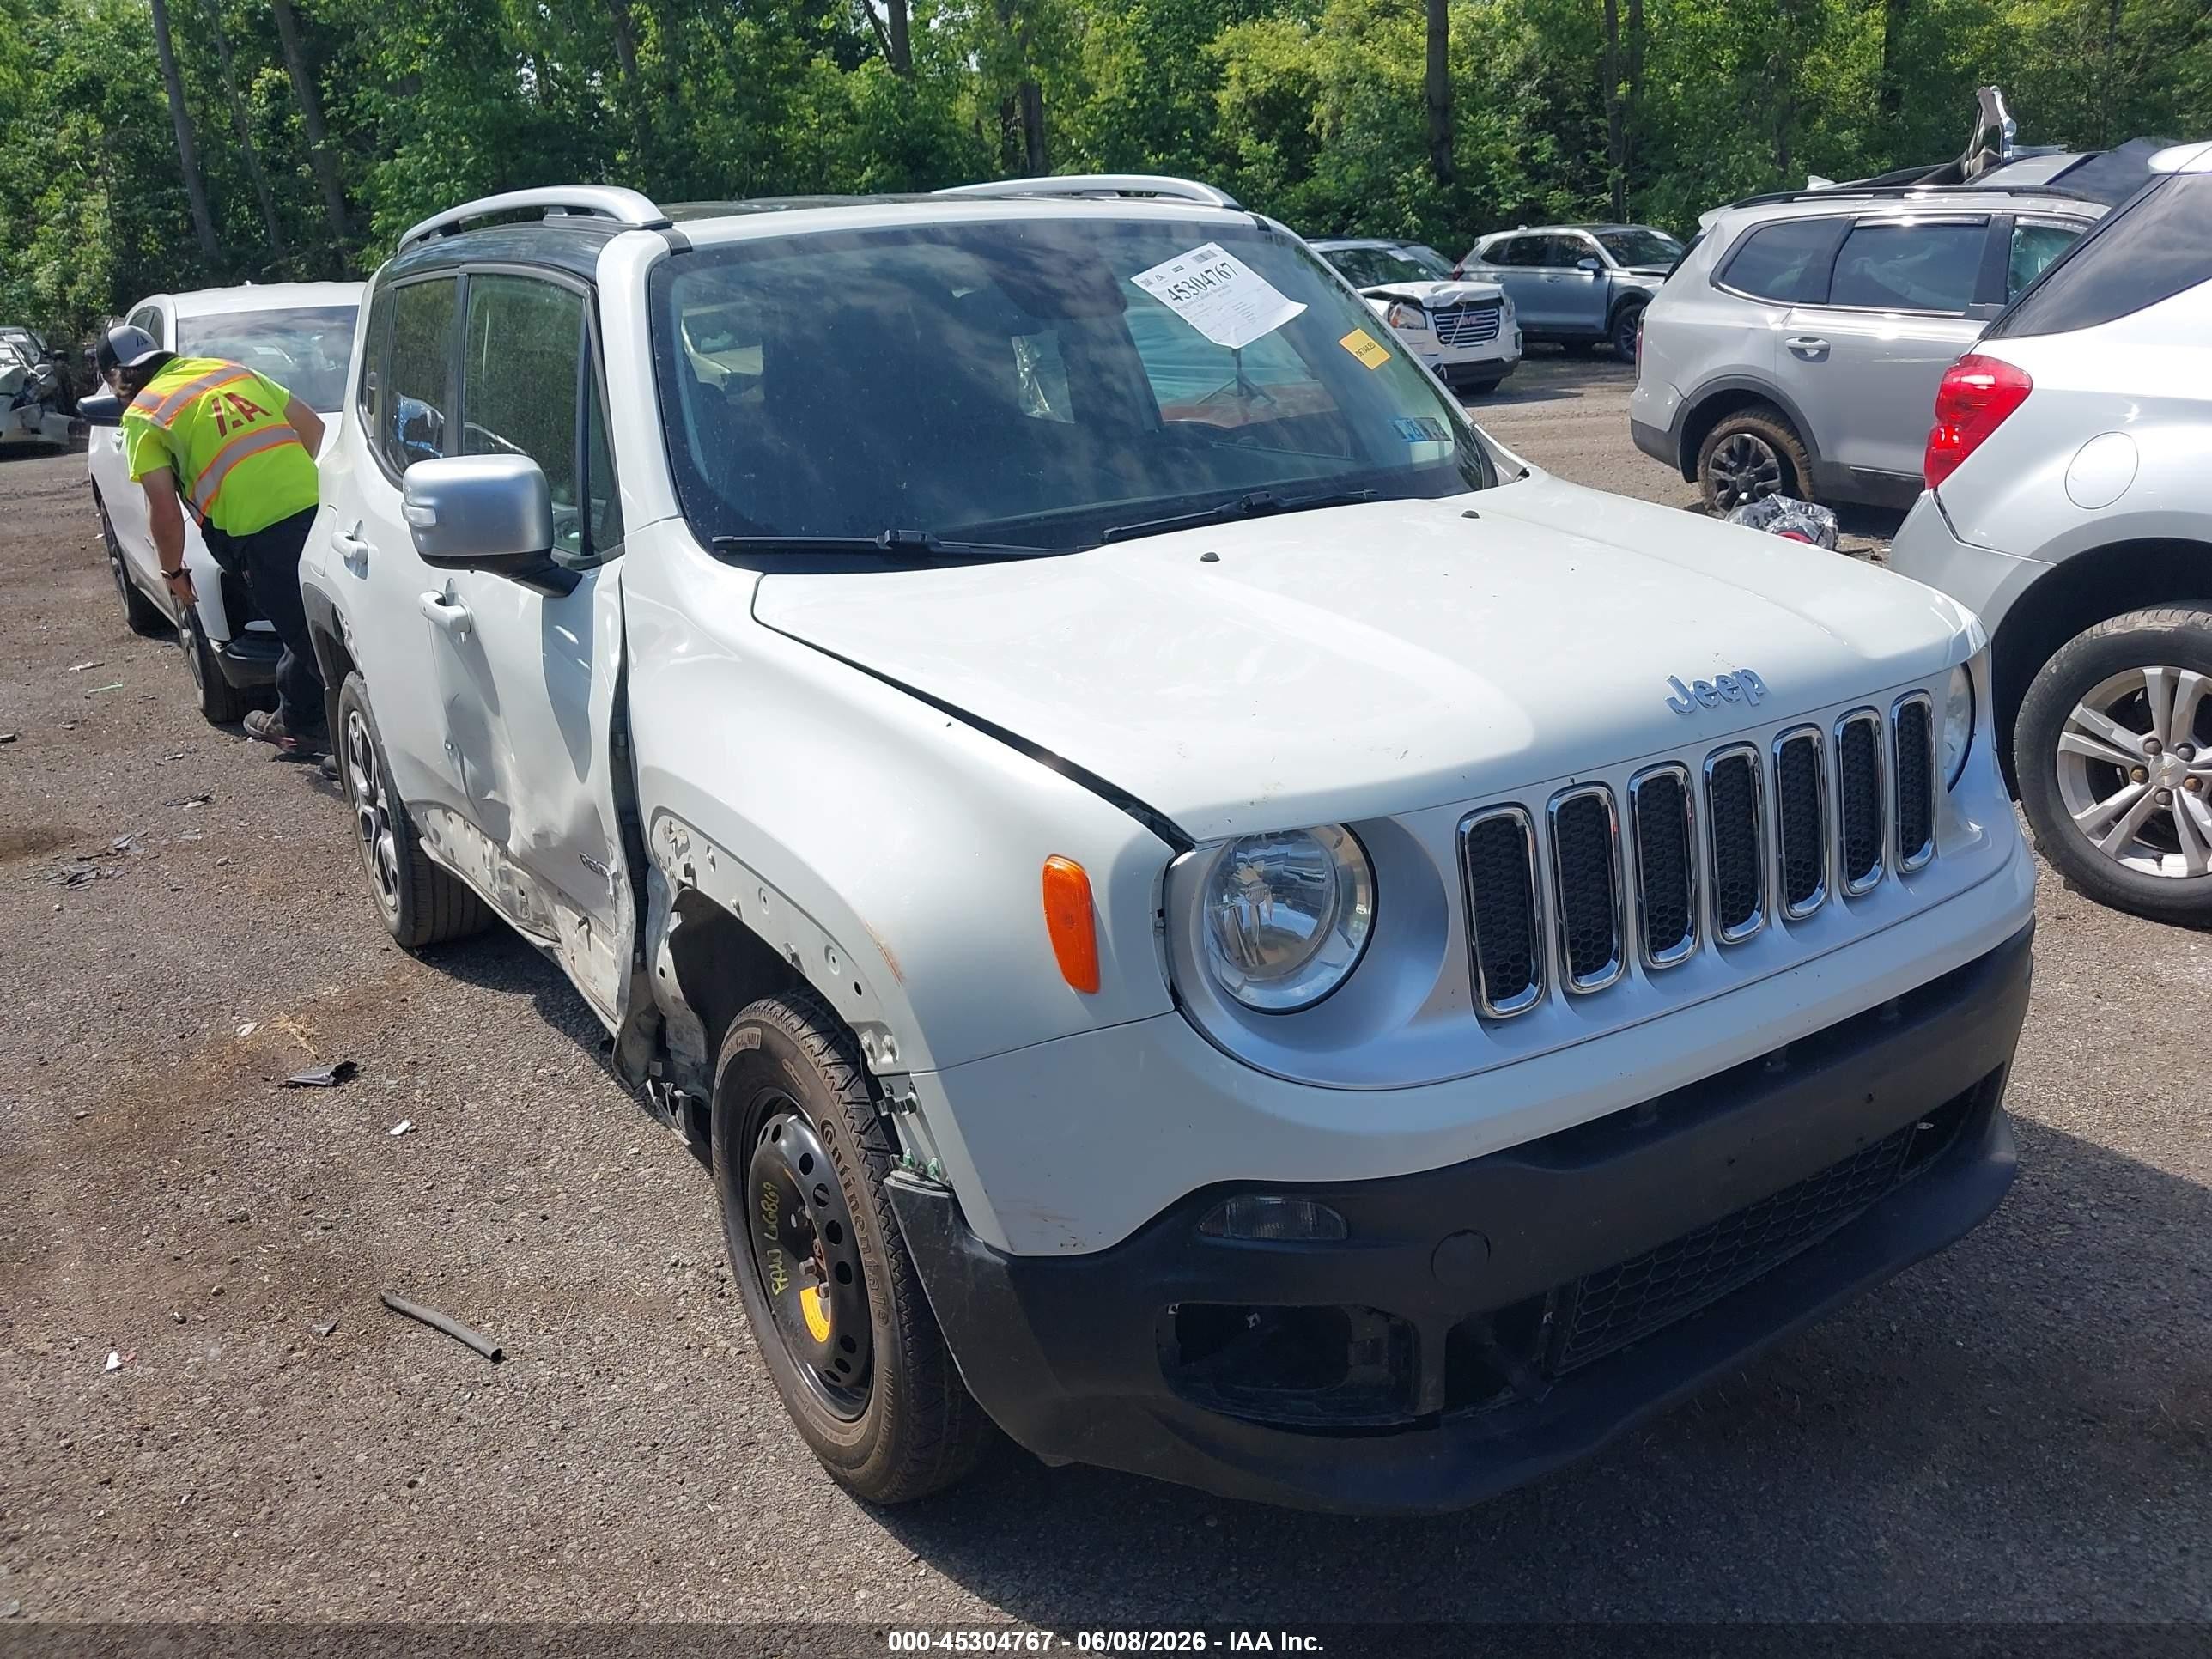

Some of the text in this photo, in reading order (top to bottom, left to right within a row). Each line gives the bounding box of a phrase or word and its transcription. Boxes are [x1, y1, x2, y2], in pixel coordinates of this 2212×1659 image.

[1167, 262, 1238, 301] 45304767
[1665, 668, 1765, 714] Jeep
[821, 1119, 886, 1309] Continental
